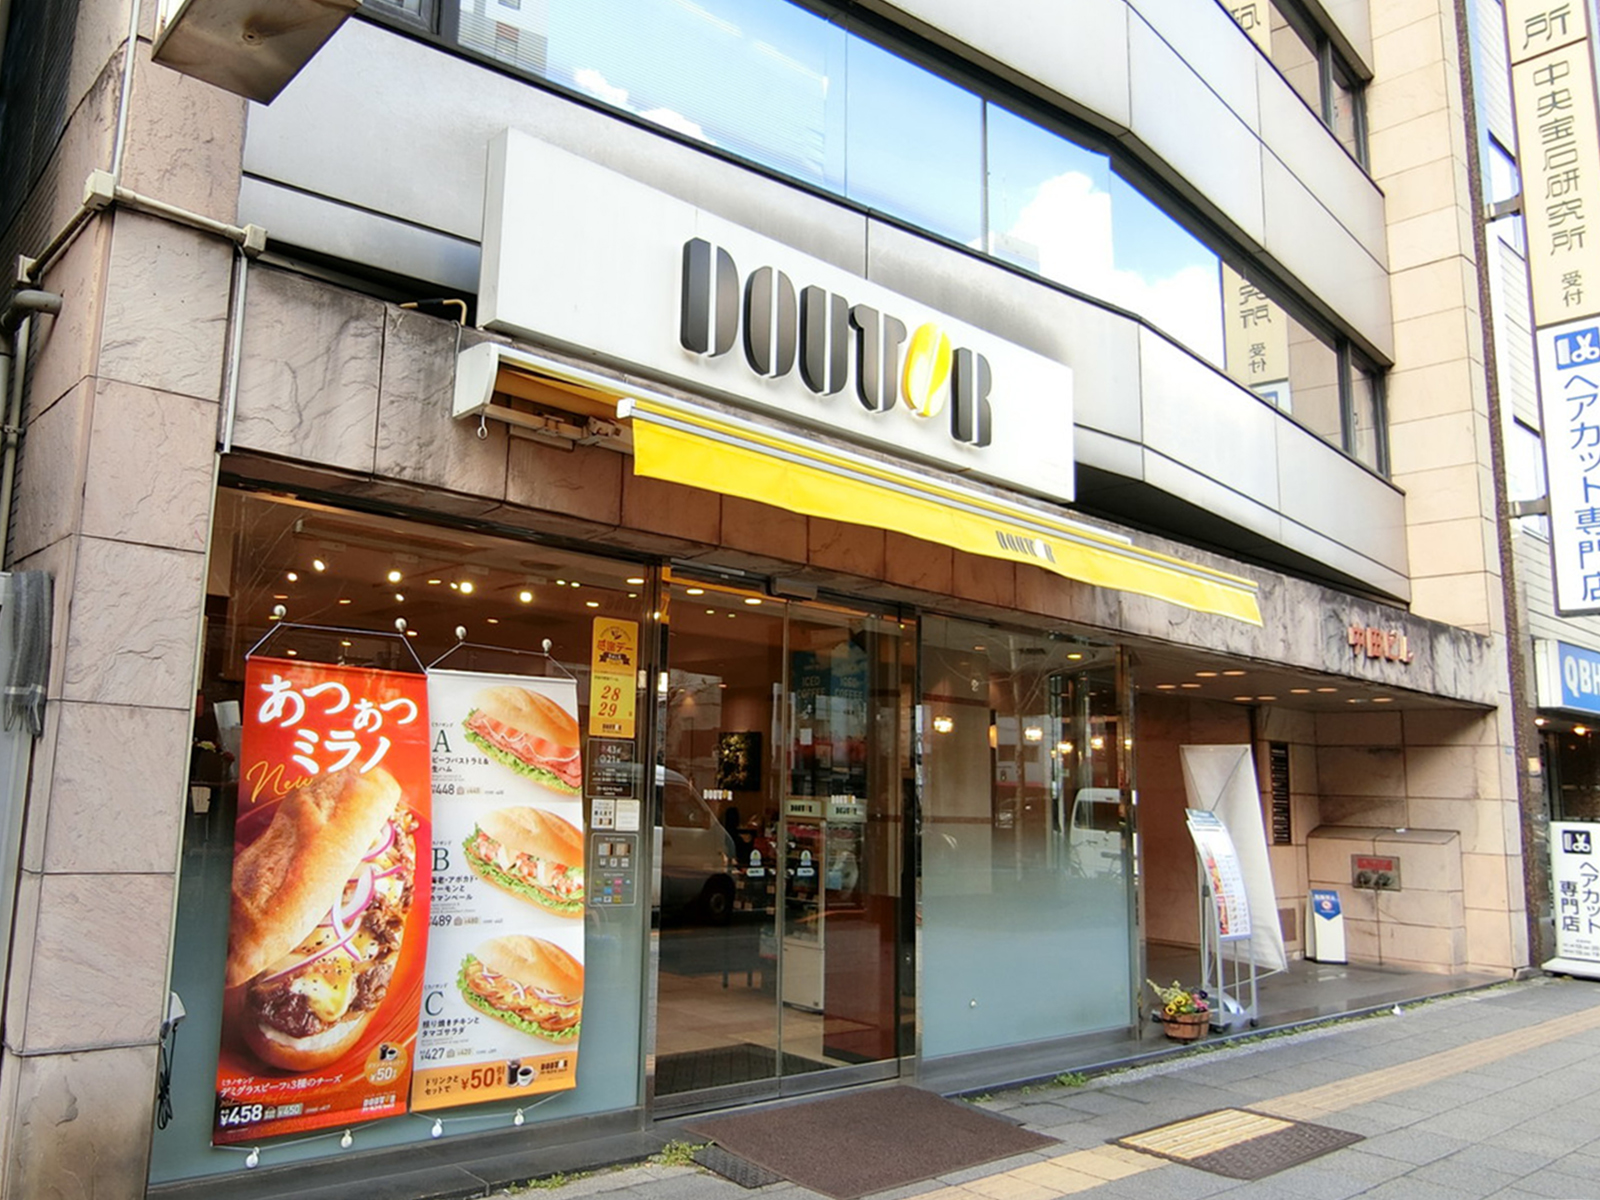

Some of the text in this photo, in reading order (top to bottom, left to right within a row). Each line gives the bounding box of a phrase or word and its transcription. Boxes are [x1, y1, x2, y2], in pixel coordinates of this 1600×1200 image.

[1523, 3, 1571, 49] 所
[1533, 60, 1586, 256] 中央宝石研究所
[1562, 270, 1584, 307] 受付
[680, 236, 992, 449] DOUTOR
[995, 530, 1056, 564] DOUTOR
[258, 674, 418, 733] あつあつ
[598, 701, 618, 718] 29
[600, 685, 621, 701] 28
[292, 728, 391, 775] ミラノ
[432, 729, 452, 752] A
[246, 761, 313, 803] New
[432, 847, 450, 872] B
[1560, 880, 1580, 932] 専門店
[425, 991, 444, 1016] C
[220, 1104, 262, 1127] ¥458
